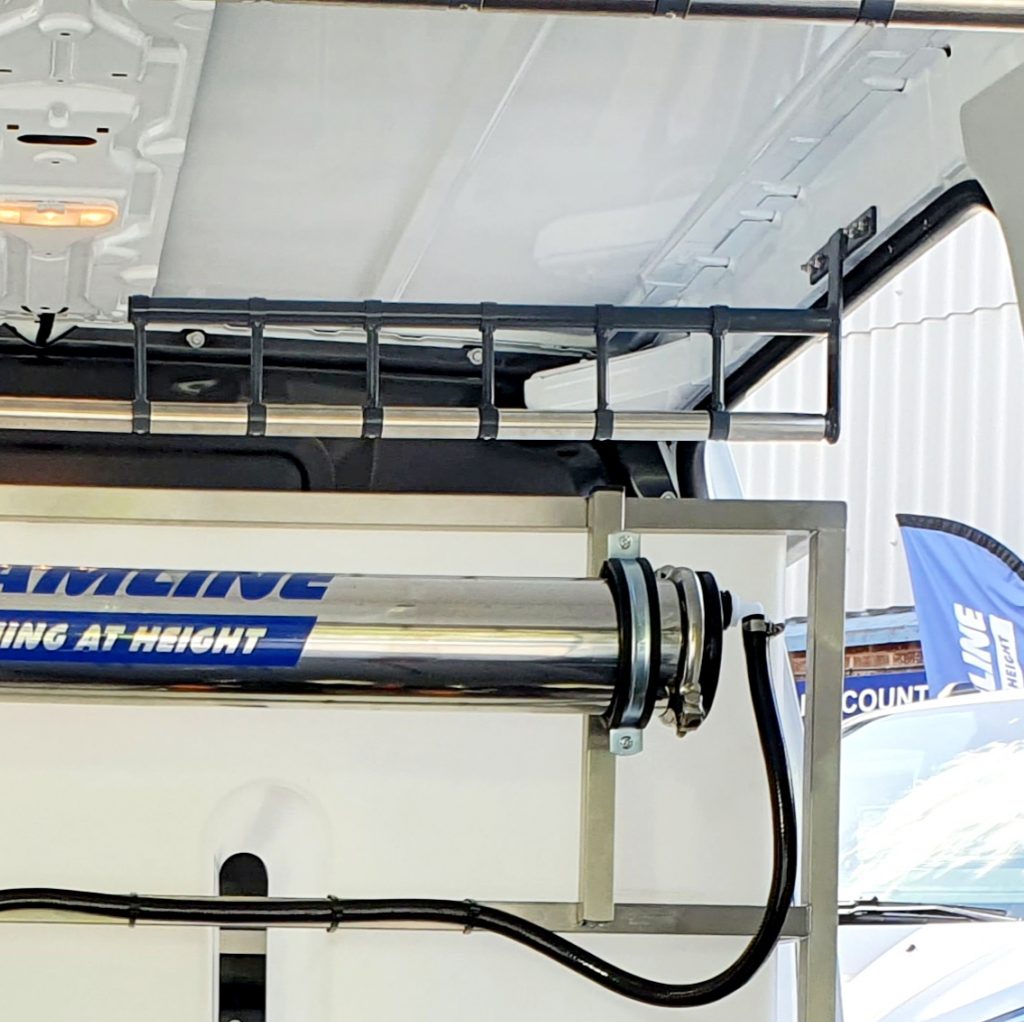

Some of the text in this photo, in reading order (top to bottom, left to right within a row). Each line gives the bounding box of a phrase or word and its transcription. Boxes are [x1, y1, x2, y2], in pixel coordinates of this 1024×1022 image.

[75, 624, 127, 652] AT
[128, 625, 268, 655] HEIGHT
[997, 634, 1018, 689] HEIGHT
